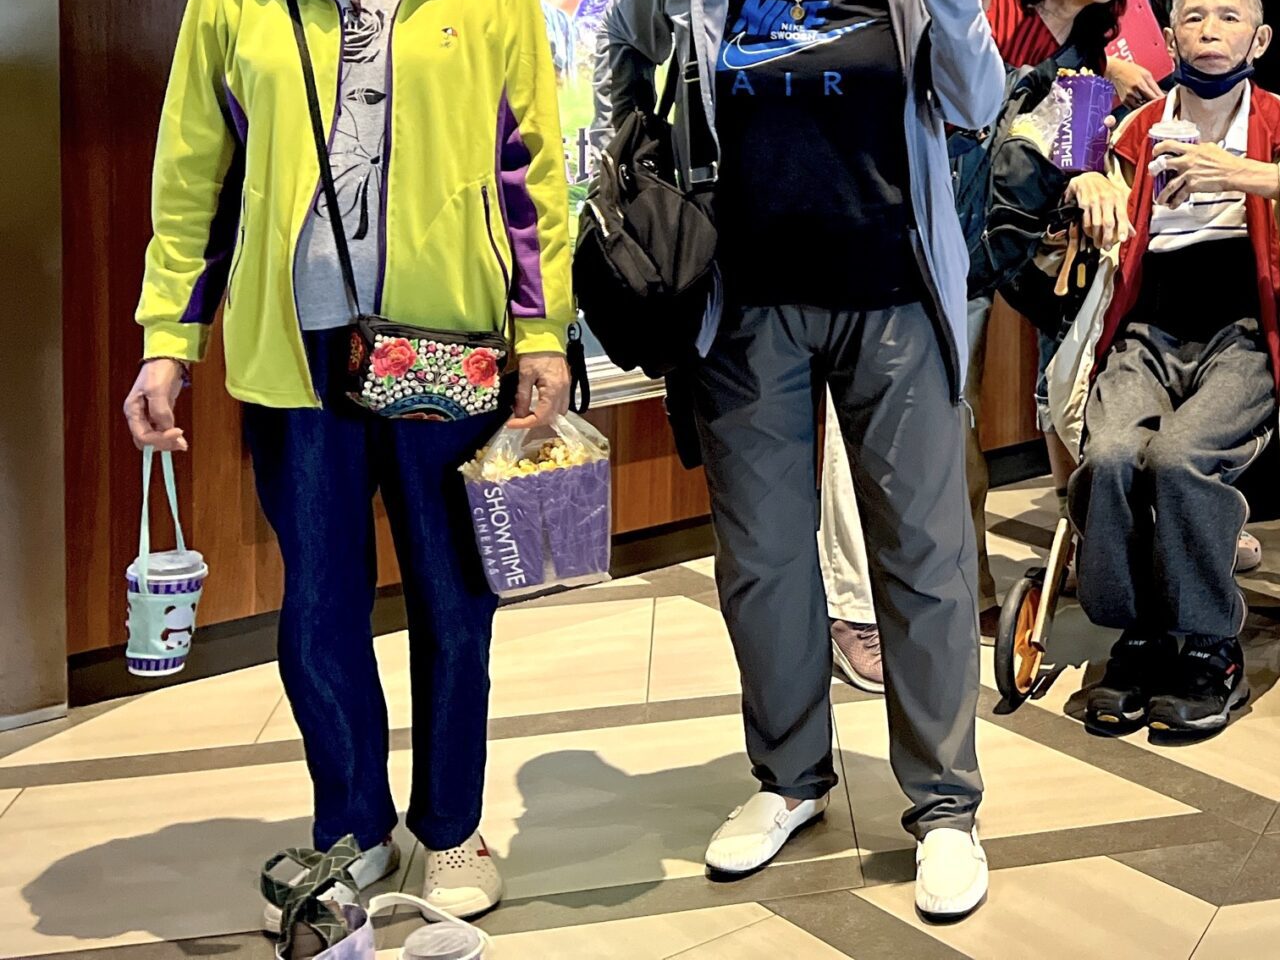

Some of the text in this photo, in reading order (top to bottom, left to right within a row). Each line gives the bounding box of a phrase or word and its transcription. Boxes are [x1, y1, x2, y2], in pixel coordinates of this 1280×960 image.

[731, 70, 844, 97] AIR
[473, 507, 500, 576] CINEMAS
[483, 486, 526, 587] SHOWTIME
